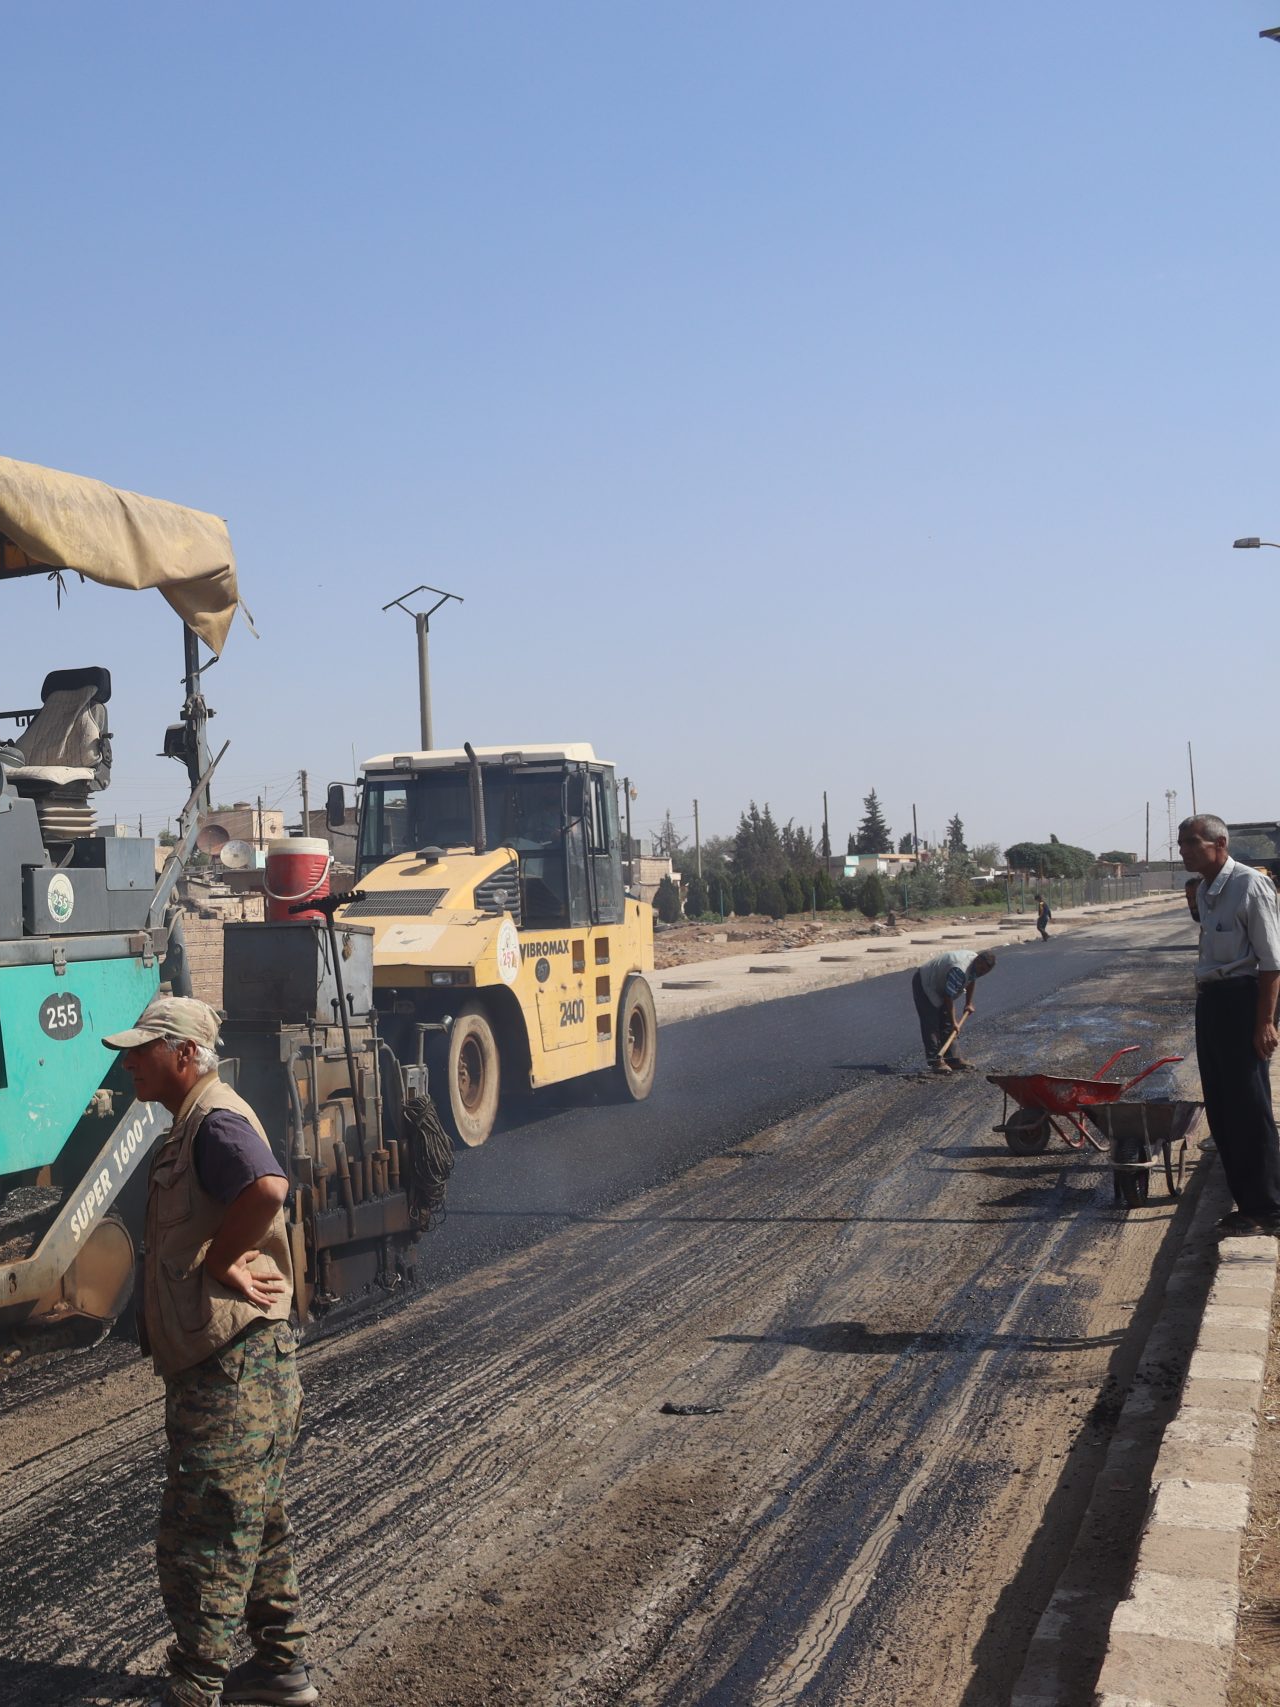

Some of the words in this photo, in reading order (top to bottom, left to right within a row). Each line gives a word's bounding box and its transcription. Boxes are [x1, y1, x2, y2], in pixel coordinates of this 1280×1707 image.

[519, 939, 569, 967] VIBROMAX
[46, 1003, 78, 1029] 255
[560, 999, 584, 1027] 2400
[70, 1168, 113, 1242] SUPER
[113, 1102, 154, 1174] 1600-1
